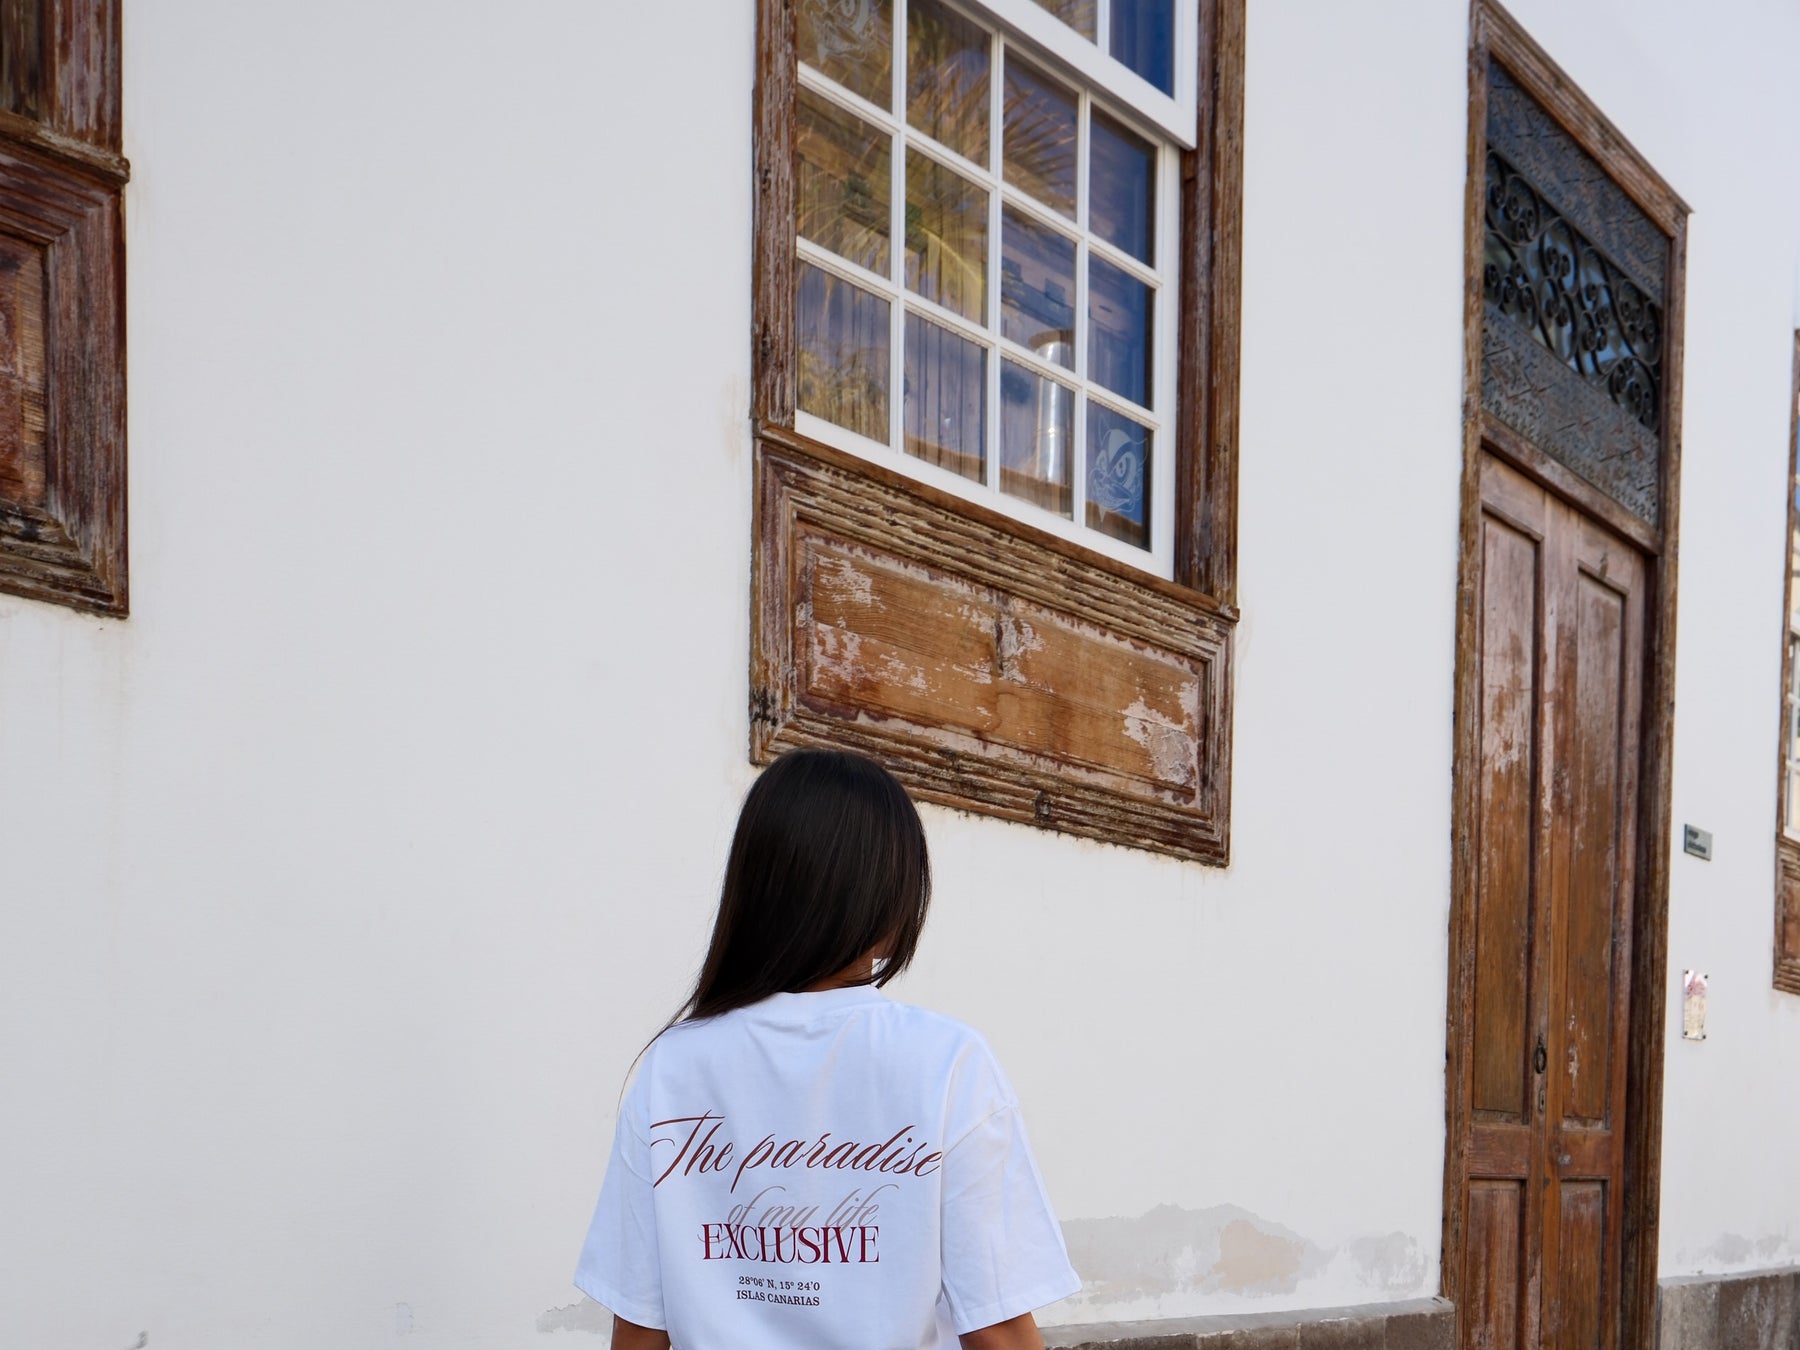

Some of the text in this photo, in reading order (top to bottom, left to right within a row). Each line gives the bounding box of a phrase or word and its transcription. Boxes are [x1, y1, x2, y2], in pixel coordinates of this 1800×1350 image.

[650, 1109, 943, 1194] The paradise
[697, 1184, 900, 1247] of my life
[701, 1223, 880, 1264] EXCLUSIVE
[736, 1289, 821, 1307] ISLAS CANARIAS
[766, 1279, 778, 1290] N,
